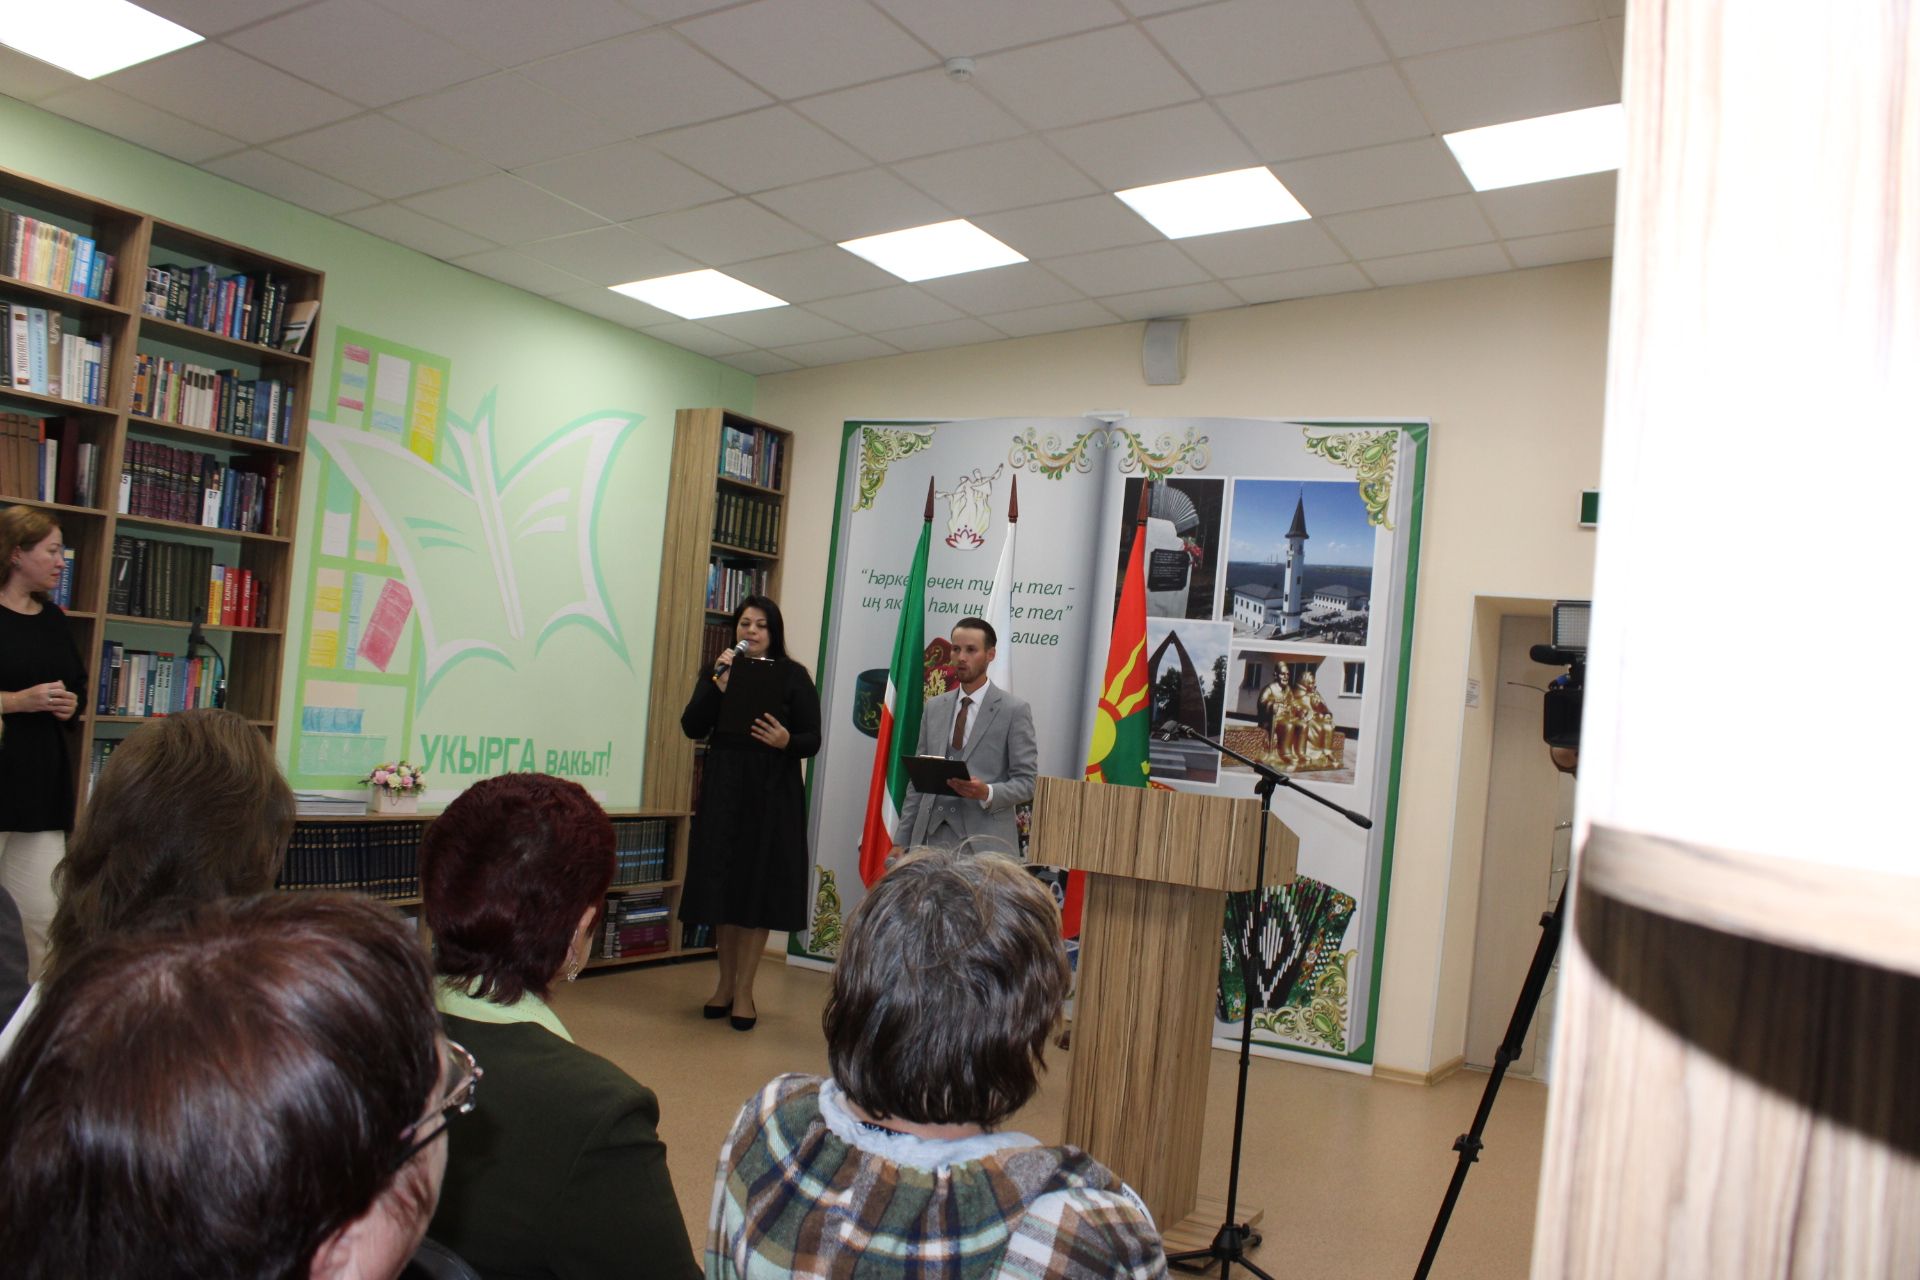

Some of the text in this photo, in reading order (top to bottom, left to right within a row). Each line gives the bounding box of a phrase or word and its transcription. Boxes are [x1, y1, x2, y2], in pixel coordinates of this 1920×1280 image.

[861, 569, 910, 590] “Һәрке
[927, 577, 964, 589] өчен
[968, 580, 1022, 596] тун
[1027, 582, 1063, 596] тел
[862, 597, 882, 612] иң
[884, 598, 904, 610] як
[928, 597, 960, 614] һәм
[963, 603, 984, 619] иң
[1010, 631, 1059, 646] әлиев
[420, 734, 536, 775] УКЫРГА
